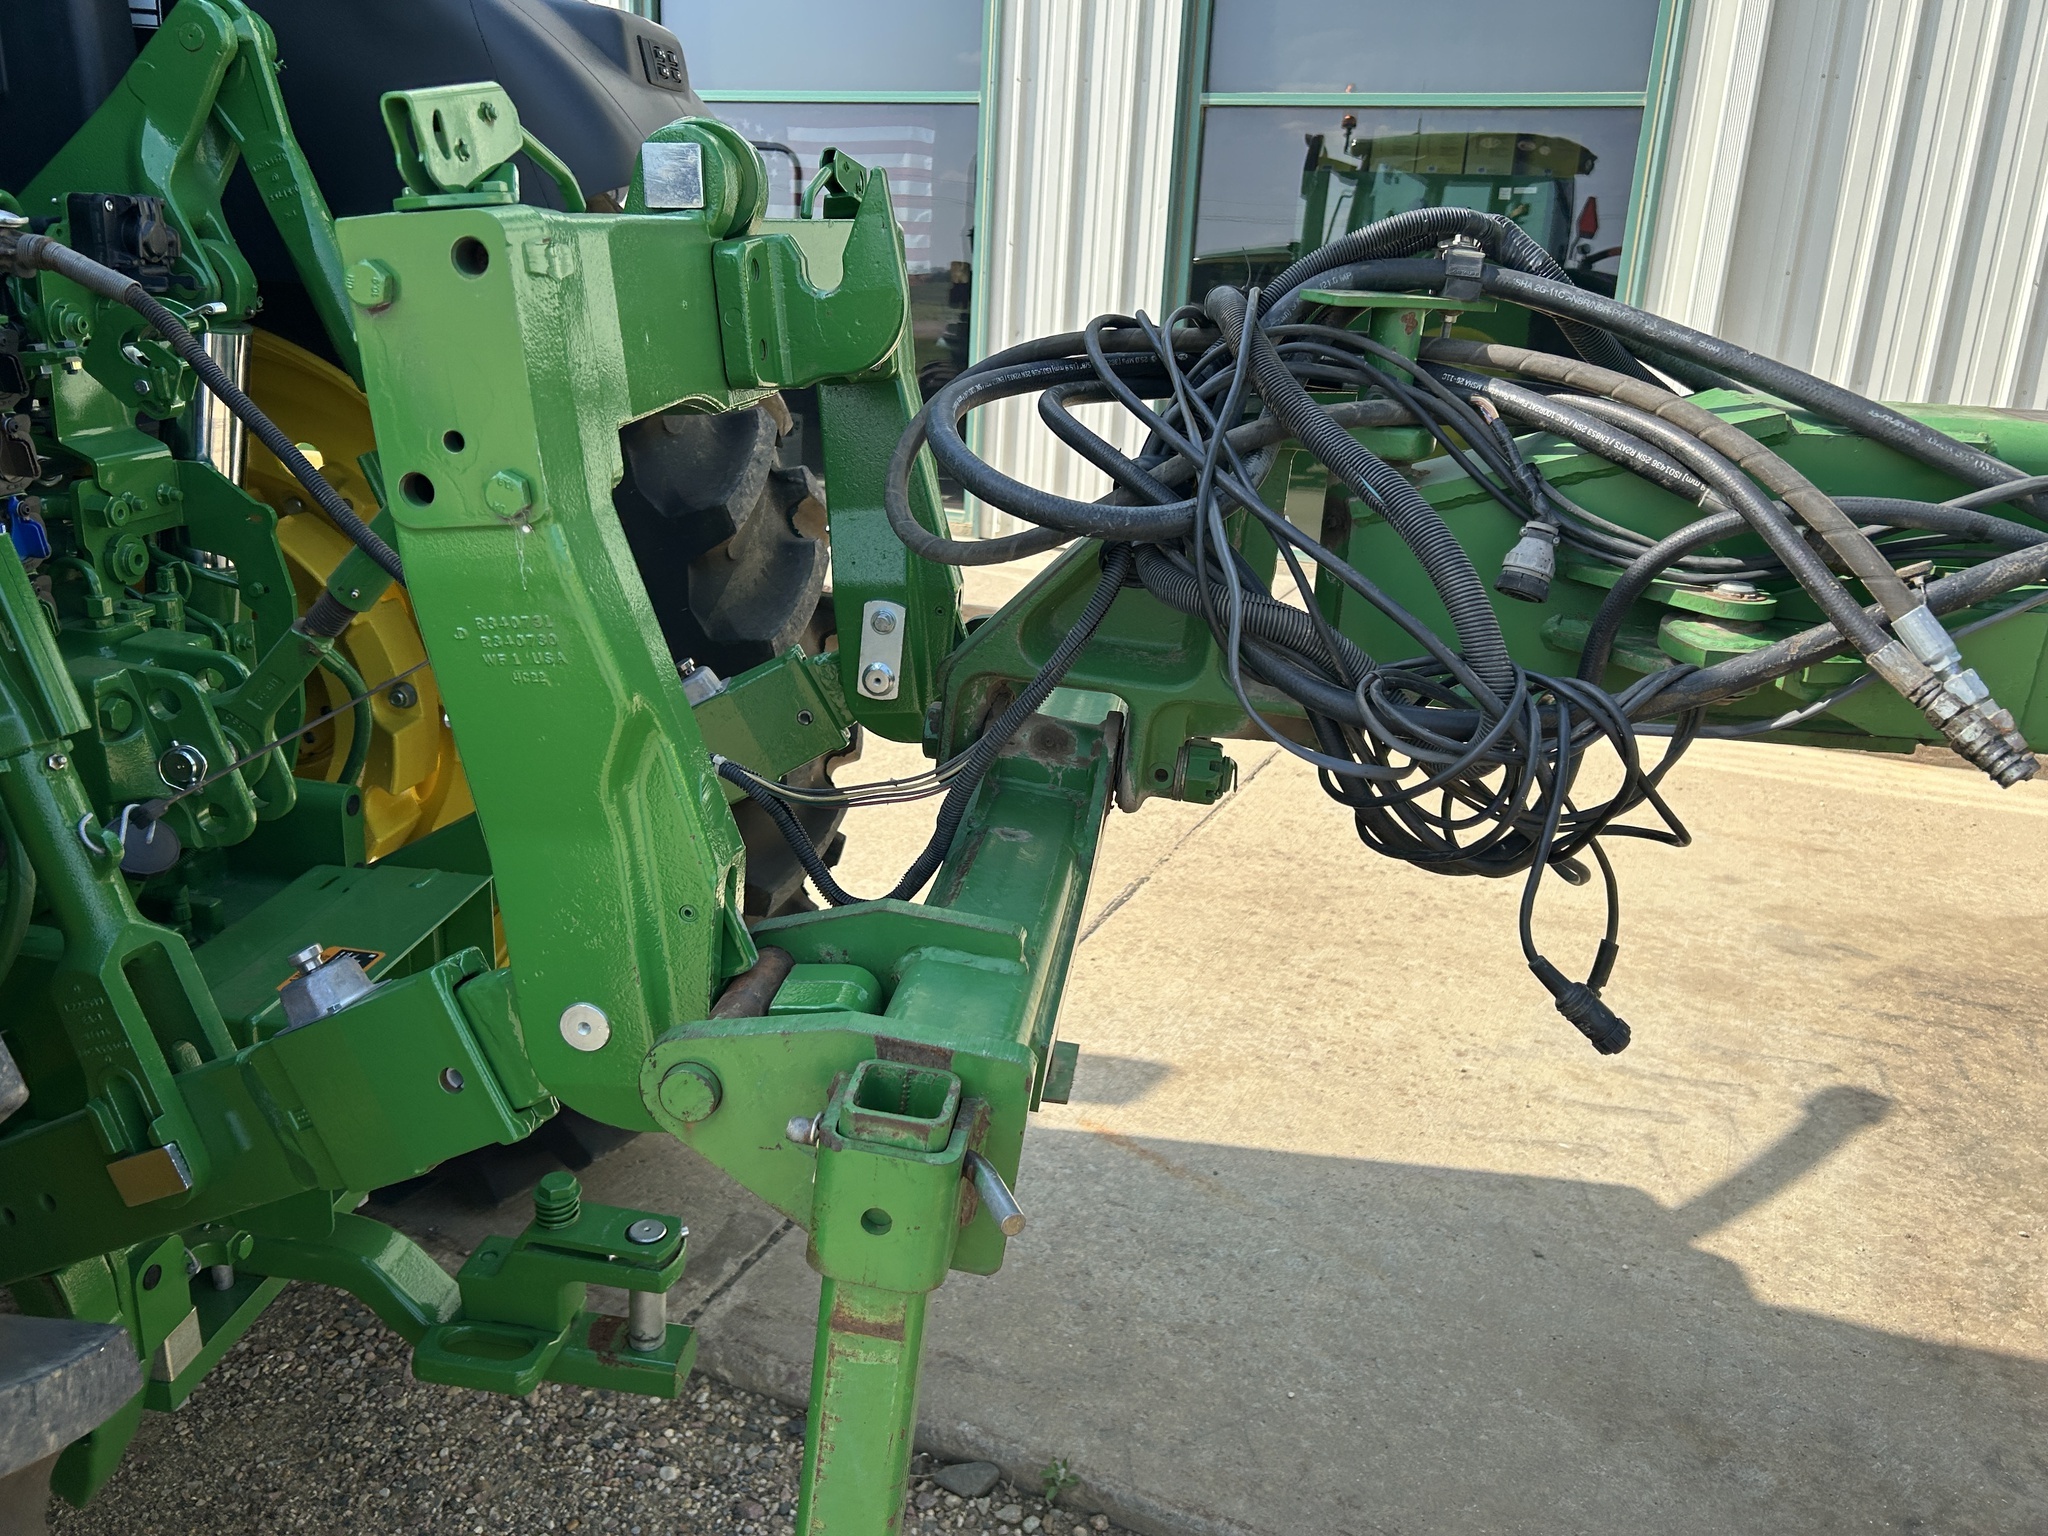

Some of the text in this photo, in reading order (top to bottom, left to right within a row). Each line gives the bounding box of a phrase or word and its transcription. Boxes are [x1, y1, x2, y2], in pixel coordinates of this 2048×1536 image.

[1441, 371, 1466, 386] 2G-11C
[1464, 378, 1485, 392] MSHA
[1528, 402, 1556, 420] 100R2AT
[1554, 413, 1570, 425] SAE
[1572, 421, 1589, 435] 2SN
[1586, 427, 1611, 445] EN853
[1613, 440, 1637, 458] R2ATS
[1635, 450, 1652, 466] 2SN
[1651, 459, 1683, 480] ISO1436
[531, 651, 570, 667] USA
